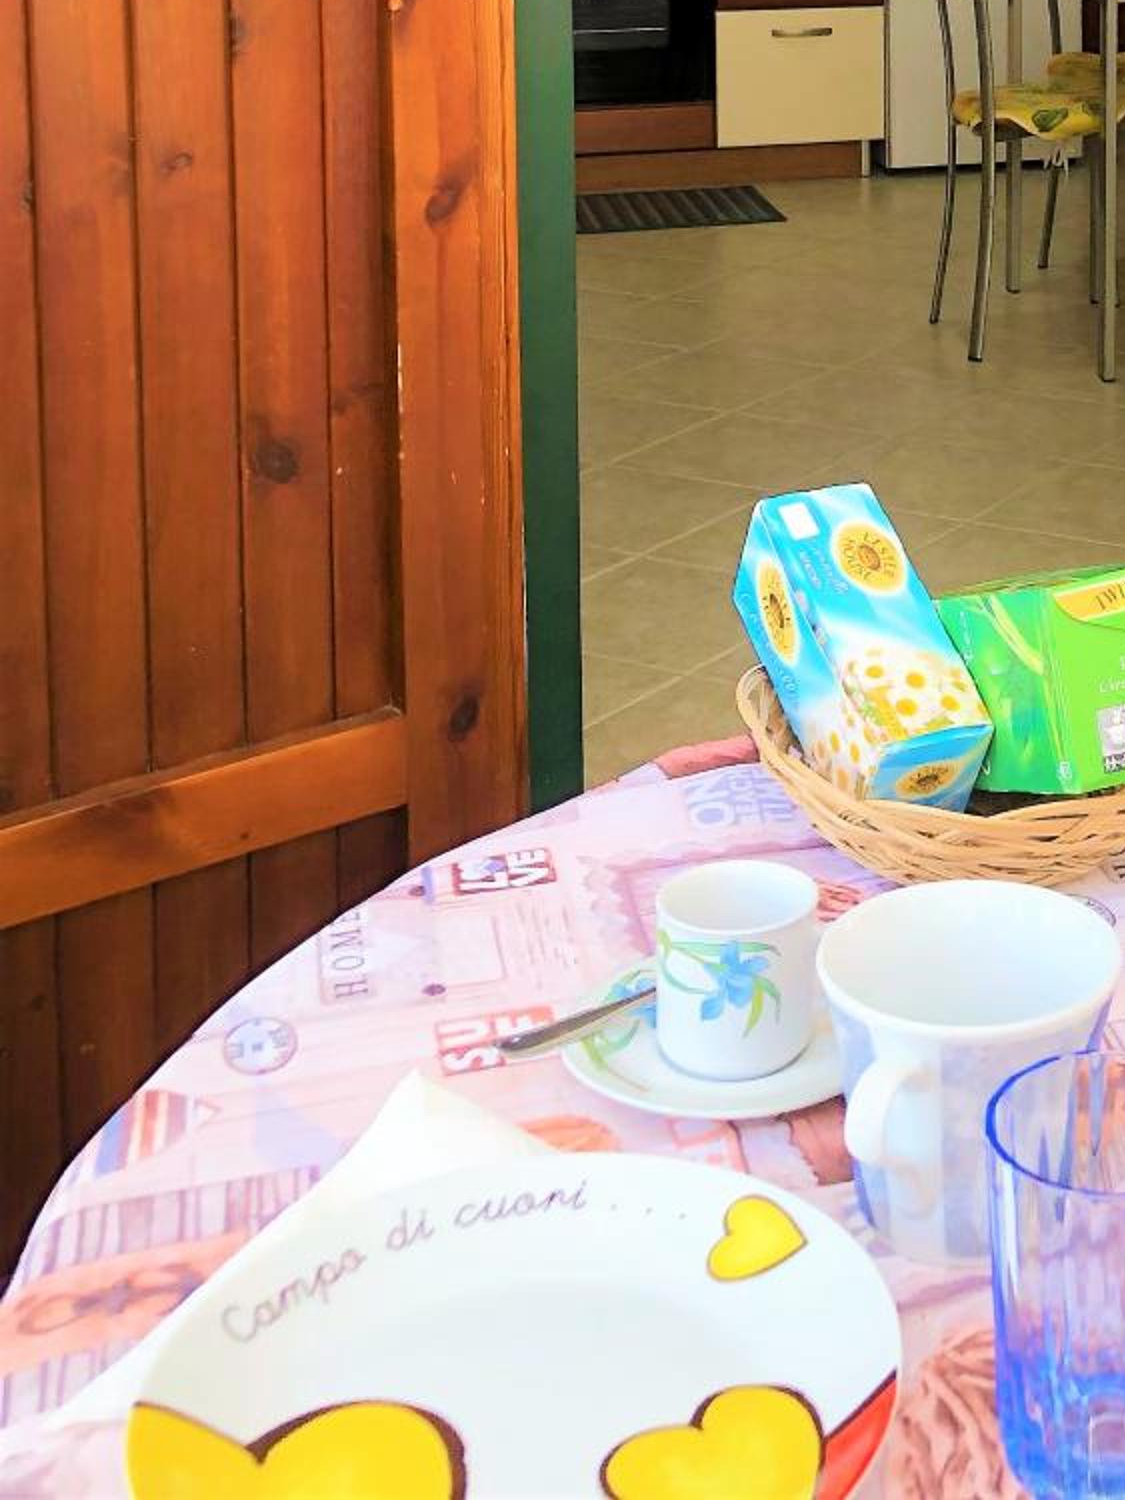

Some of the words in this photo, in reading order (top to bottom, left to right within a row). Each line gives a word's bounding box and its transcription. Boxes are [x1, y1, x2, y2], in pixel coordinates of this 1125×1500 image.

[219, 1247, 367, 1344] Campo
[385, 1208, 436, 1253] di
[453, 1179, 588, 1229] cuori
